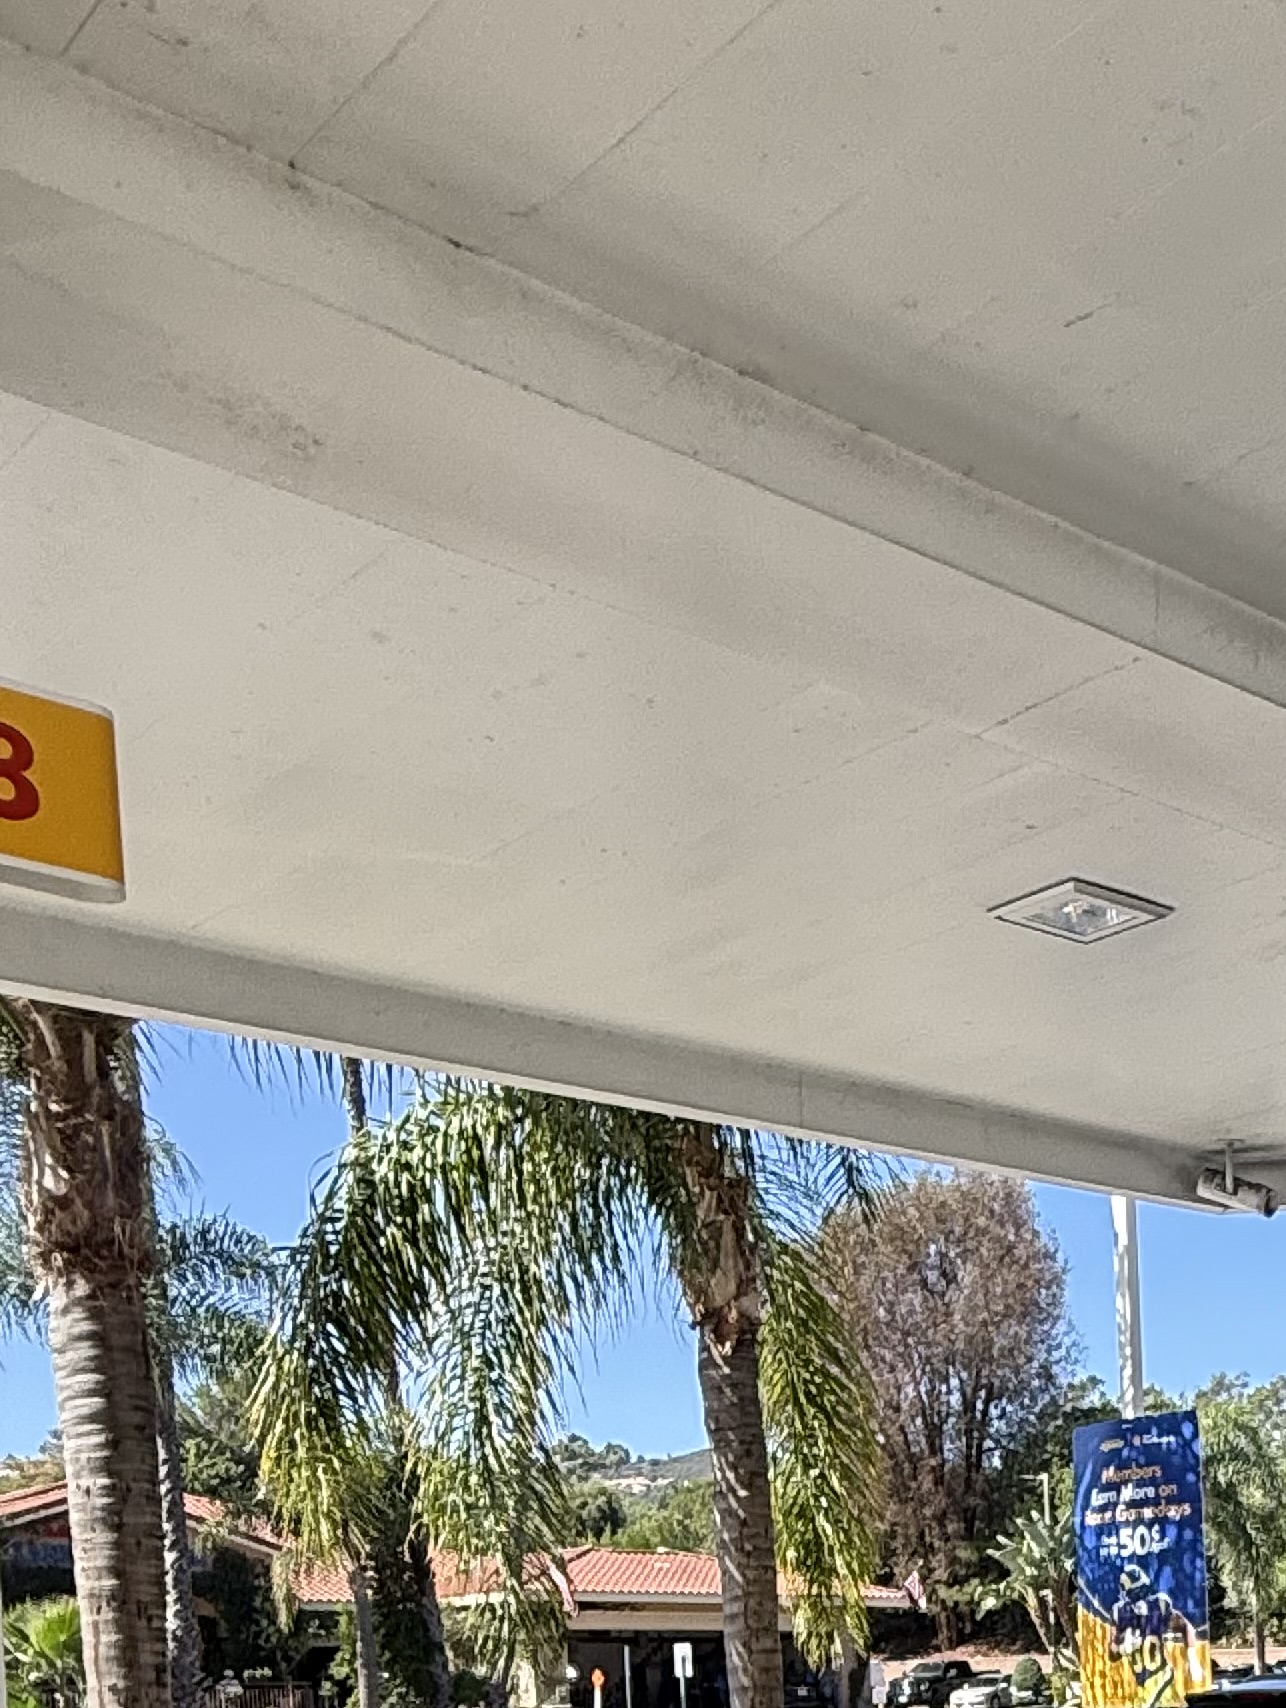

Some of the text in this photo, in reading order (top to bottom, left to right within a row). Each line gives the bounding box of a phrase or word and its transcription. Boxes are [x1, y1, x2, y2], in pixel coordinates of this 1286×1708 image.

[1101, 1462, 1163, 1484] Members
[1091, 1482, 1177, 1507] Earn More on
